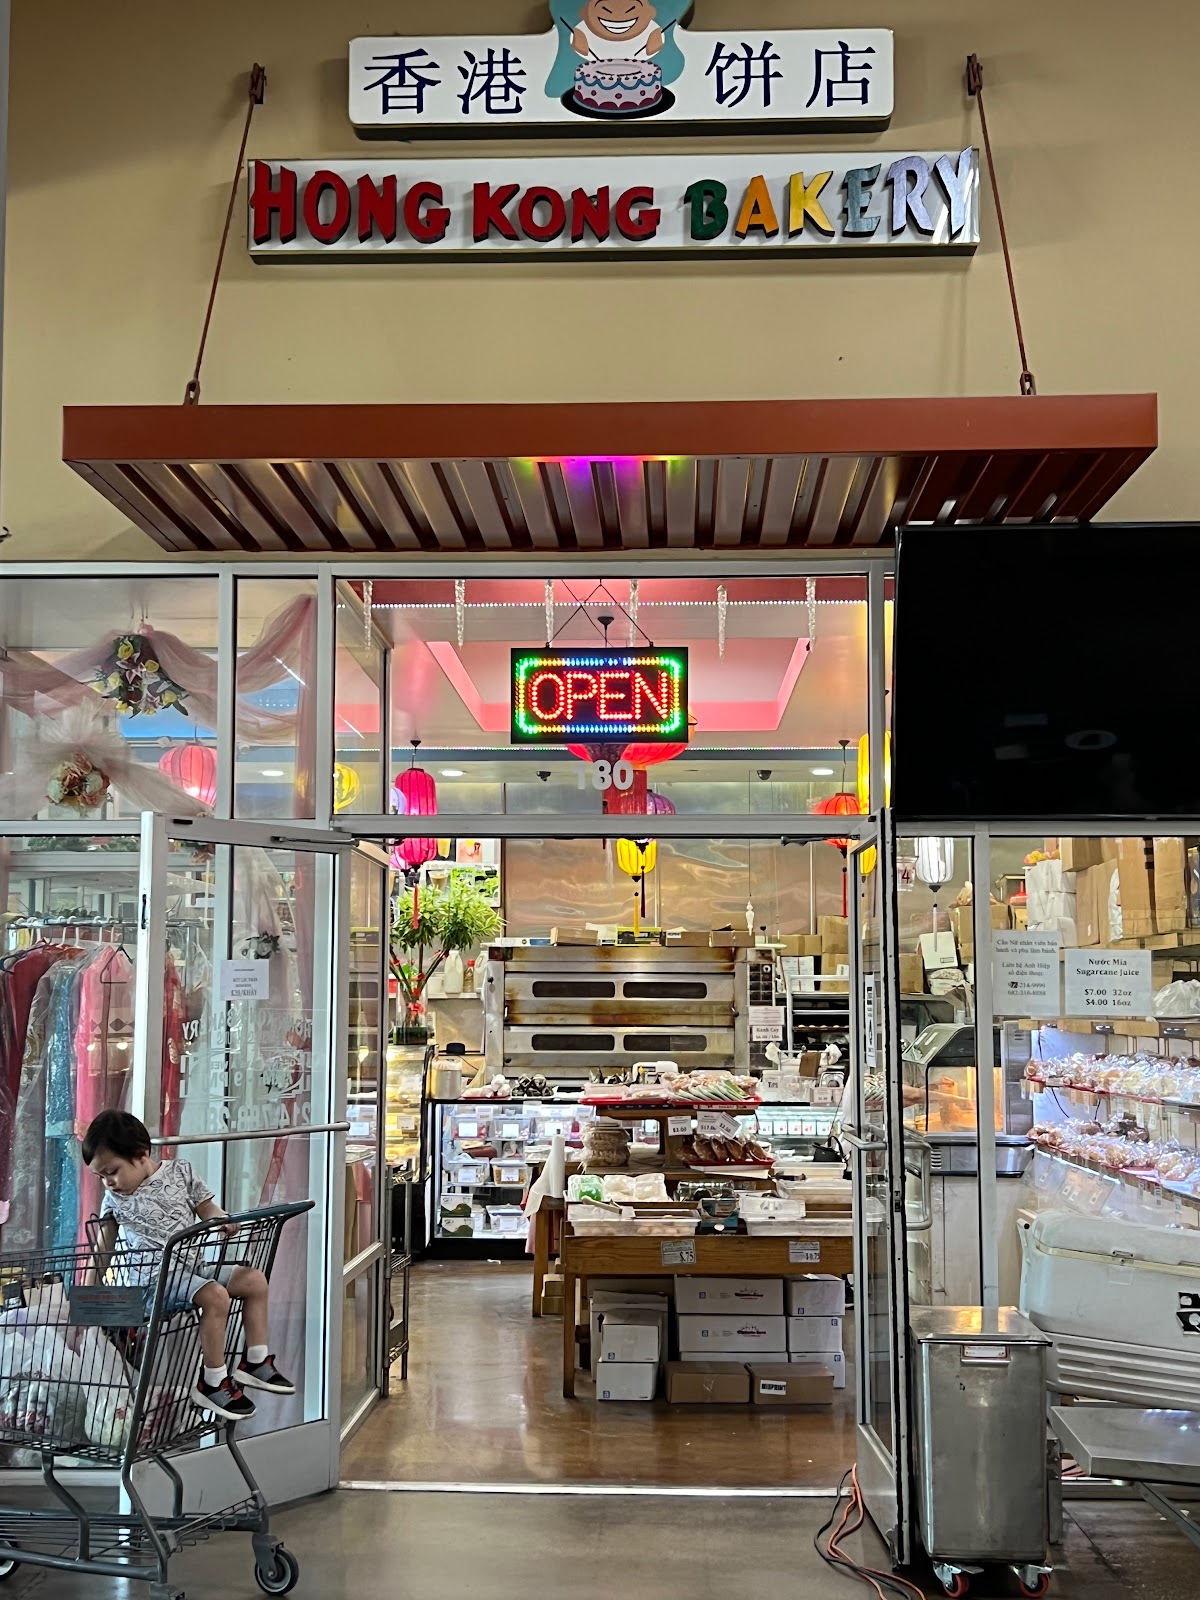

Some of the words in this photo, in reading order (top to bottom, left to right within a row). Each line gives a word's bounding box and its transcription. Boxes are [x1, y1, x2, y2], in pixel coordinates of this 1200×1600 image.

[363, 48, 527, 115] 香港
[704, 40, 876, 109] 饼店
[250, 159, 451, 245] HONG
[473, 181, 661, 243] KONG
[683, 145, 973, 241] BAKERY
[528, 670, 670, 720] OPEN
[574, 759, 634, 790] 180
[1076, 968, 1118, 977] Sugarcane
[1119, 968, 1140, 977] Juice
[1084, 988, 1107, 996] $7.00
[1112, 988, 1132, 997] 32oz
[1085, 998, 1108, 1006] $4.00
